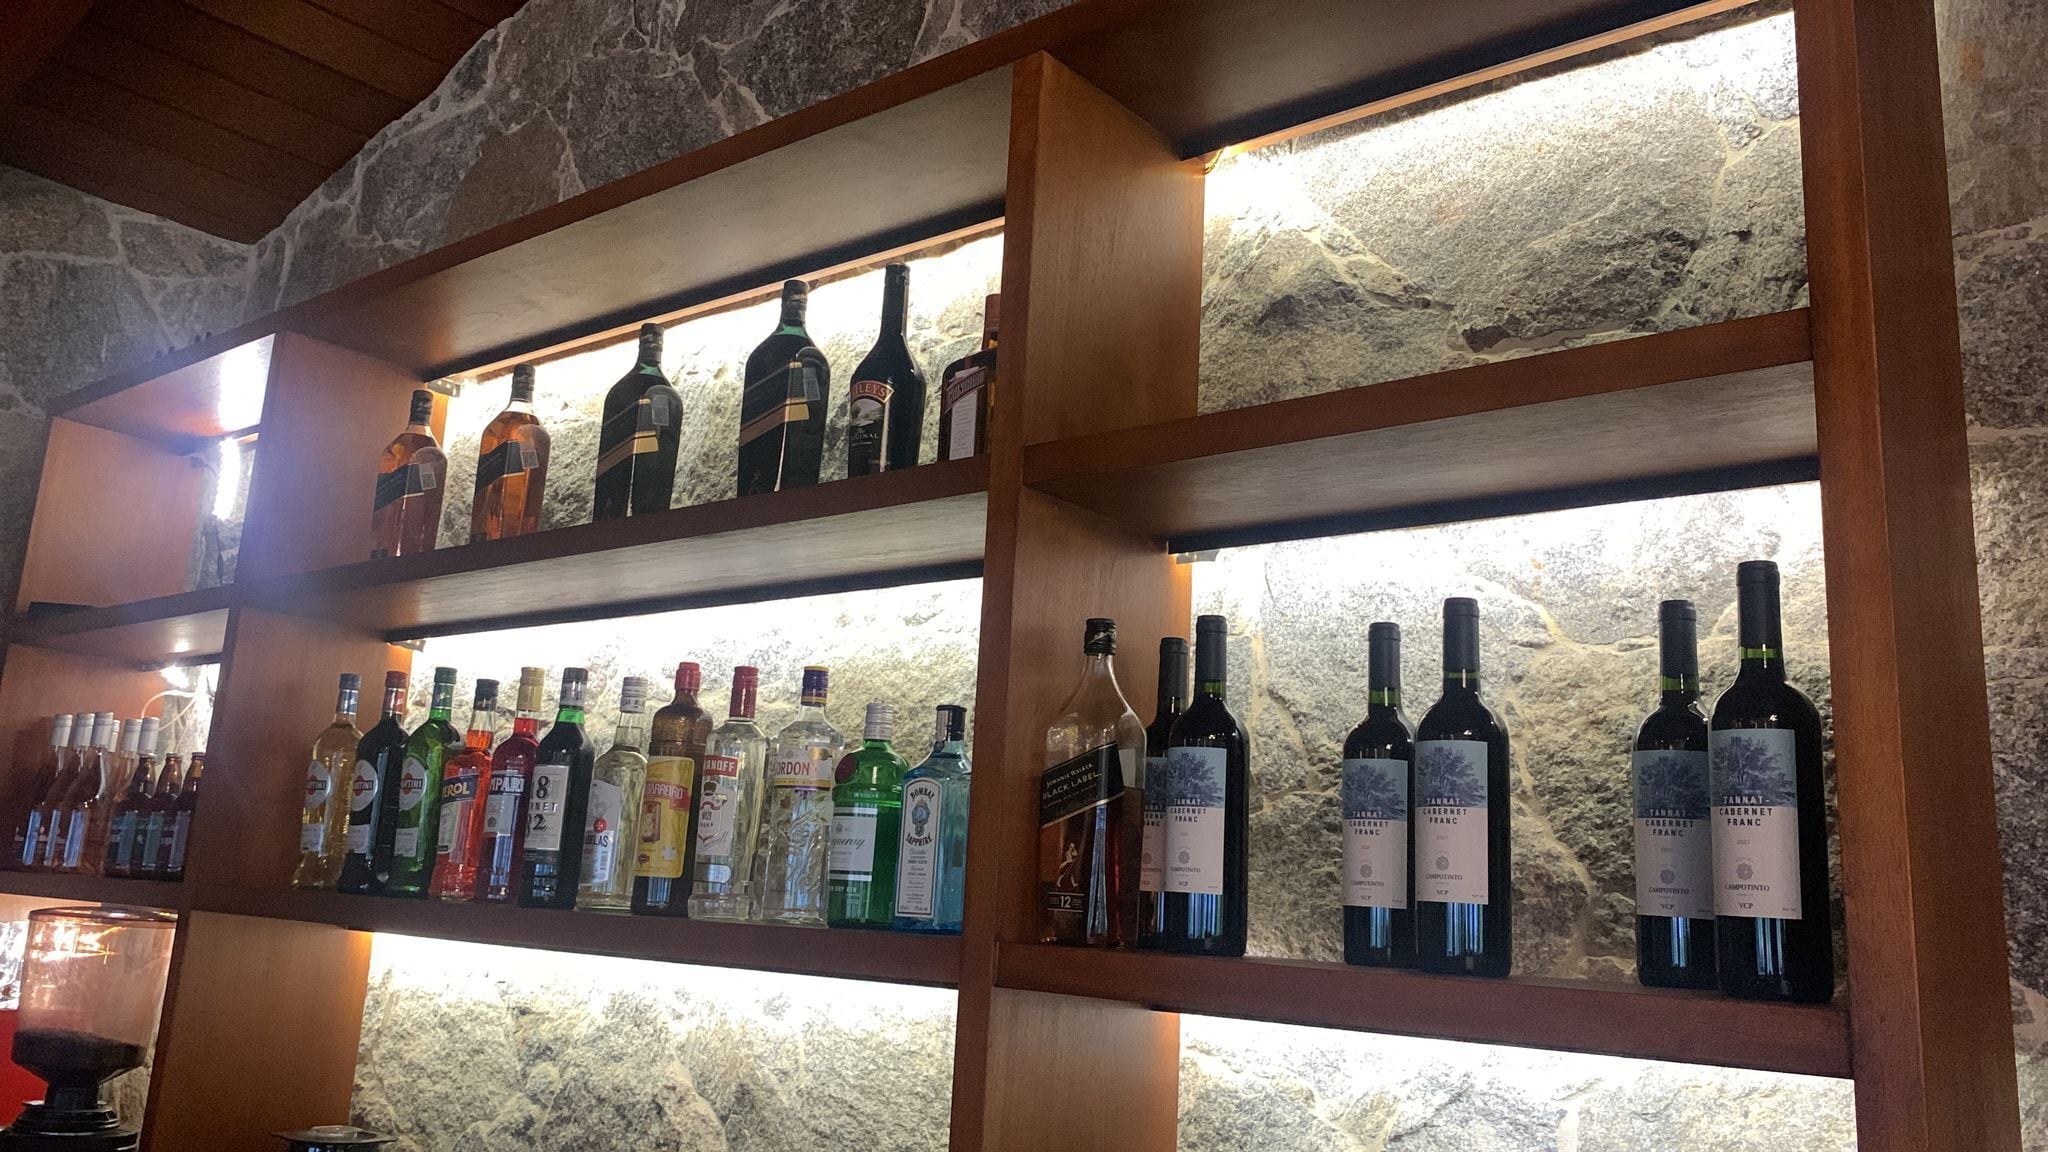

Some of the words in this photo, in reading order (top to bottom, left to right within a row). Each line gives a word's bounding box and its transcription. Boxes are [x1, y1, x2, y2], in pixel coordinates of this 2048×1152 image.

[910, 787, 935, 802] BOMBAY
[1042, 784, 1070, 801] BLACK
[1423, 807, 1468, 816] CABERNET
[1719, 807, 1773, 817] CABERNET
[1175, 815, 1198, 823] FRANC
[1429, 817, 1458, 825] FRANC
[1645, 819, 1694, 828] CABERNET
[1727, 818, 1761, 827] FRANC
[1348, 820, 1389, 828] CABERNET
[1652, 829, 1684, 837] FRANC
[905, 832, 934, 847] SAPPHIRE
[1724, 883, 1771, 893] CAMPOTINTO
[1060, 895, 1072, 909] 12
[1738, 902, 1754, 910] VCP
